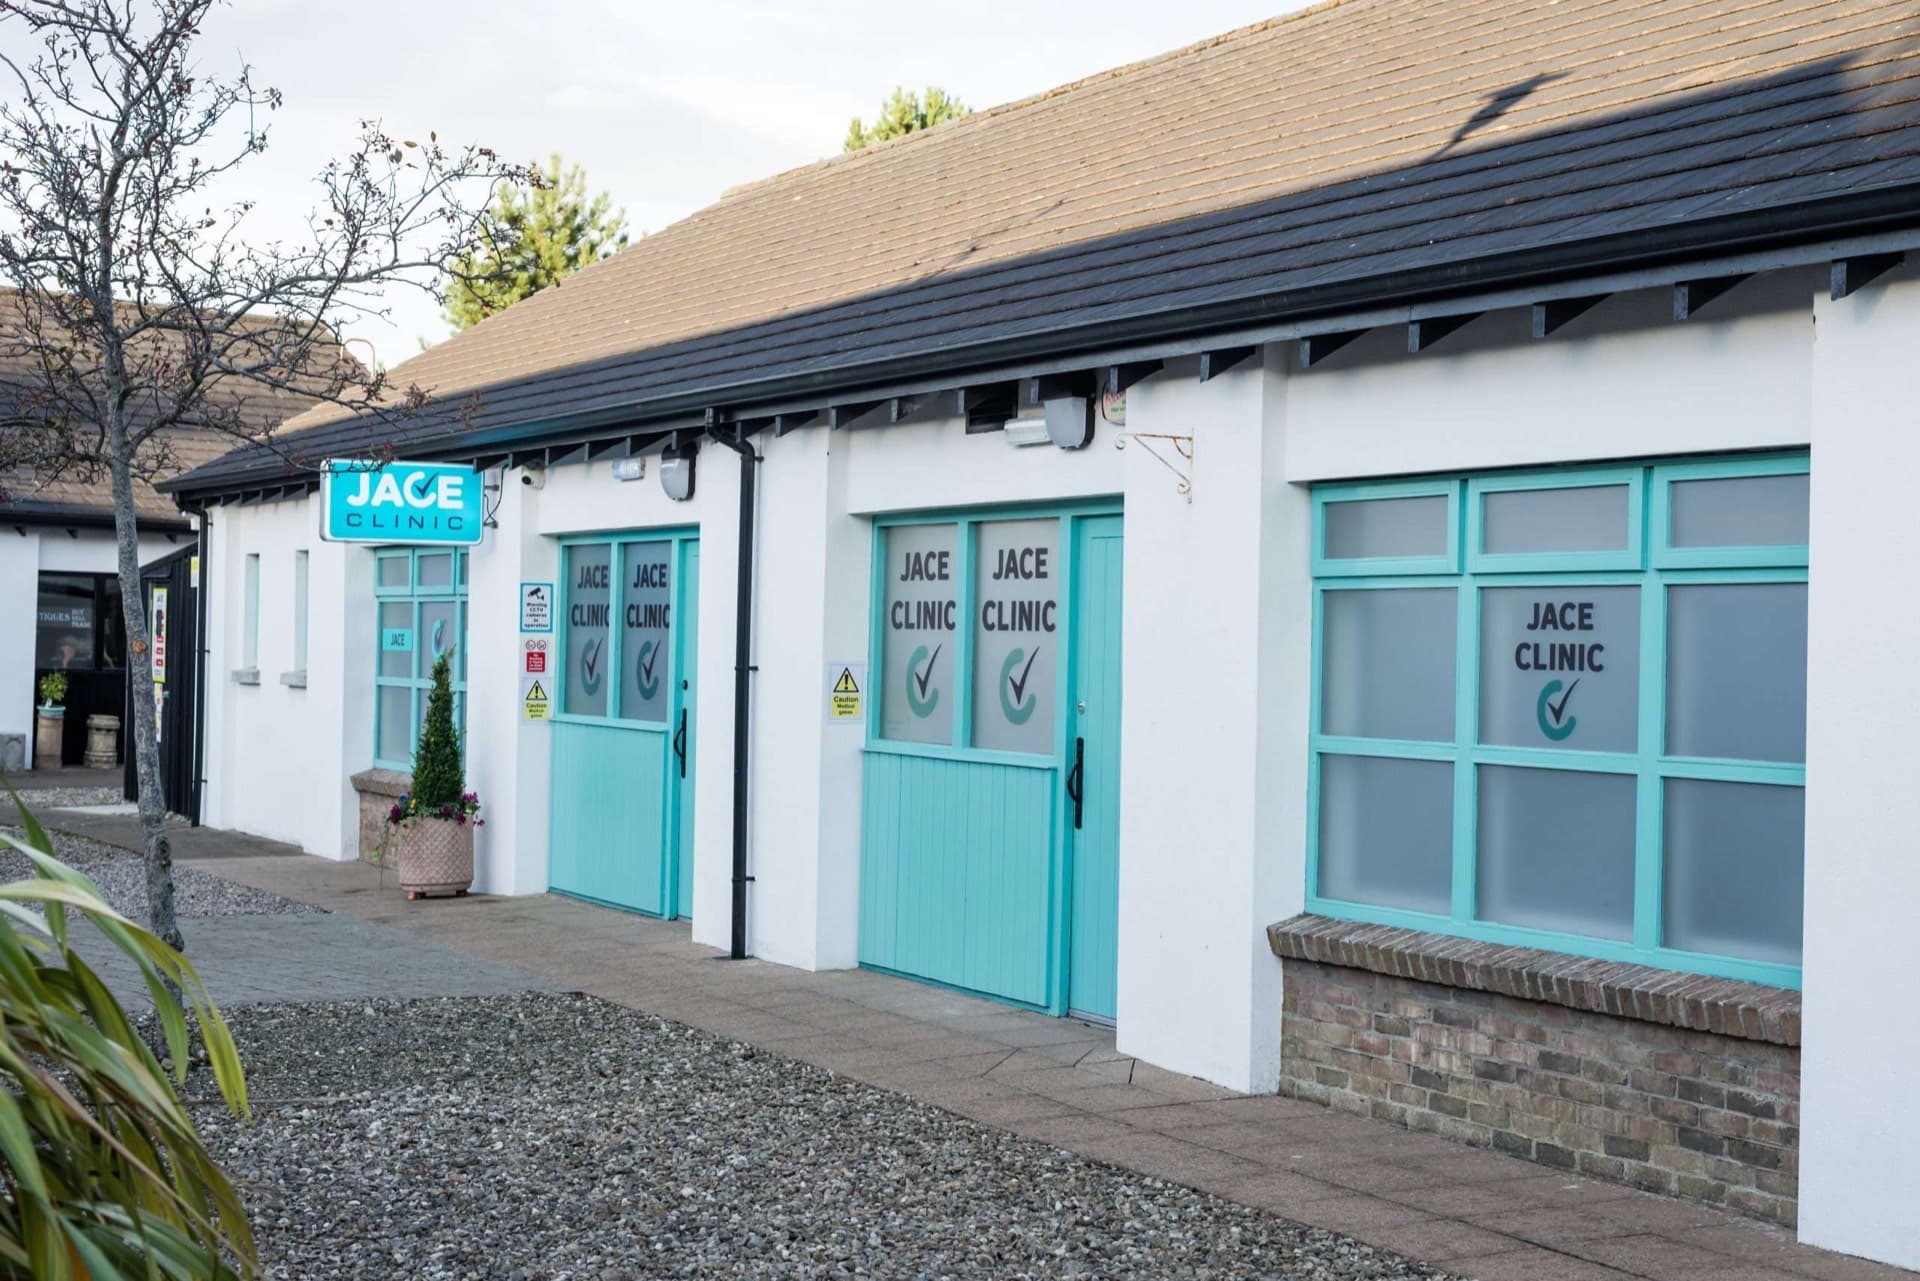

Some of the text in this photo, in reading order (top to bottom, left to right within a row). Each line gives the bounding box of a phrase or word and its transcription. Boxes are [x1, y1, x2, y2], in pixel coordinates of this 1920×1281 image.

[347, 471, 463, 509] JACE
[346, 513, 463, 530] CLINIC
[577, 565, 608, 589] JACE
[633, 563, 667, 588] JACE
[901, 550, 950, 581] JACE
[993, 547, 1048, 580] JACE
[627, 603, 670, 629] CLINIC
[891, 600, 956, 631] CLINIC
[982, 600, 1056, 632] CLINIC
[1526, 602, 1594, 631] JACE
[390, 632, 405, 646] JACE
[1515, 642, 1604, 672] CLINIC
[833, 695, 859, 703] Caution
